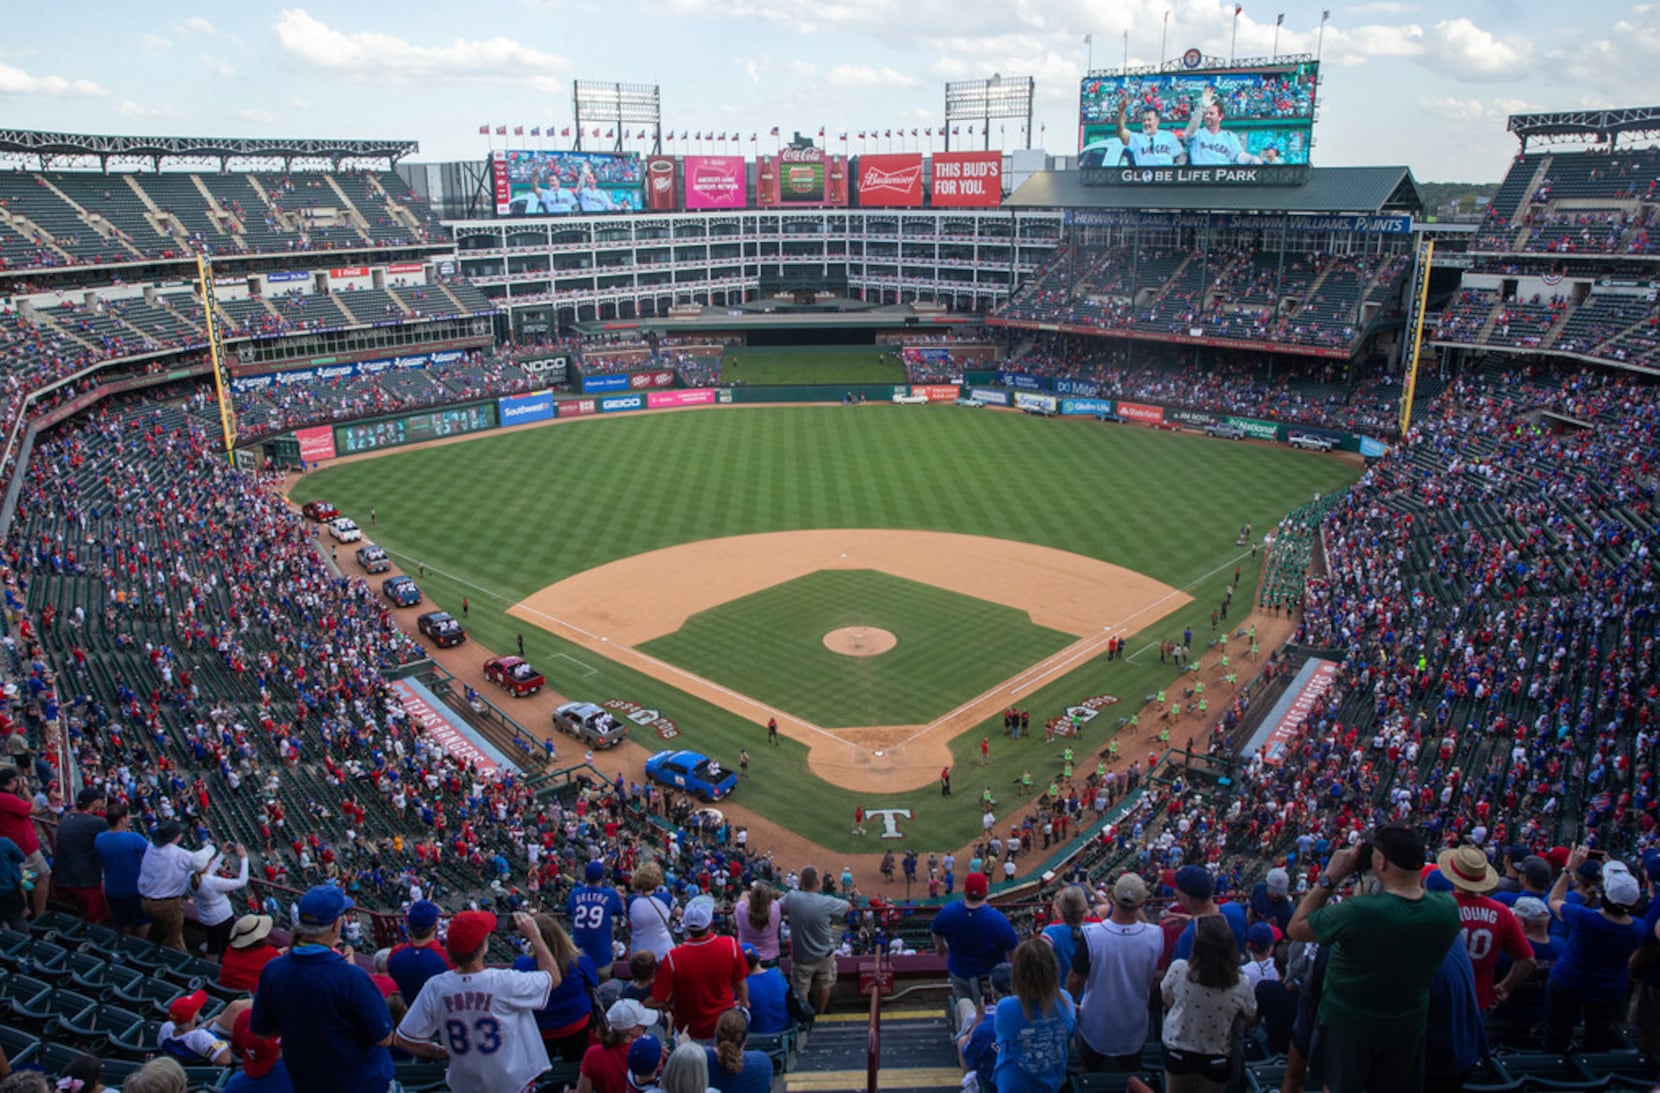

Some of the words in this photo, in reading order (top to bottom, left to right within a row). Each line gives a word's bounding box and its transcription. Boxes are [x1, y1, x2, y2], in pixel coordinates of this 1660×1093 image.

[935, 162, 961, 178] THIS
[963, 161, 998, 177] BUD'S
[1177, 169, 1210, 181] LIFE
[1215, 169, 1257, 181] PARK
[866, 173, 915, 186] Budweiser
[935, 180, 957, 195] FOR
[959, 179, 986, 195] YOU.
[520, 357, 566, 374] NOCO
[504, 403, 544, 417] Southwest
[602, 397, 641, 410] GEICO
[1239, 420, 1277, 433] National
[403, 697, 442, 727] TEXAS
[430, 724, 485, 764] RANGERS
[864, 808, 914, 839] T
[574, 904, 605, 929] 29
[443, 991, 493, 1014] POPPI
[446, 1015, 503, 1056] 83
